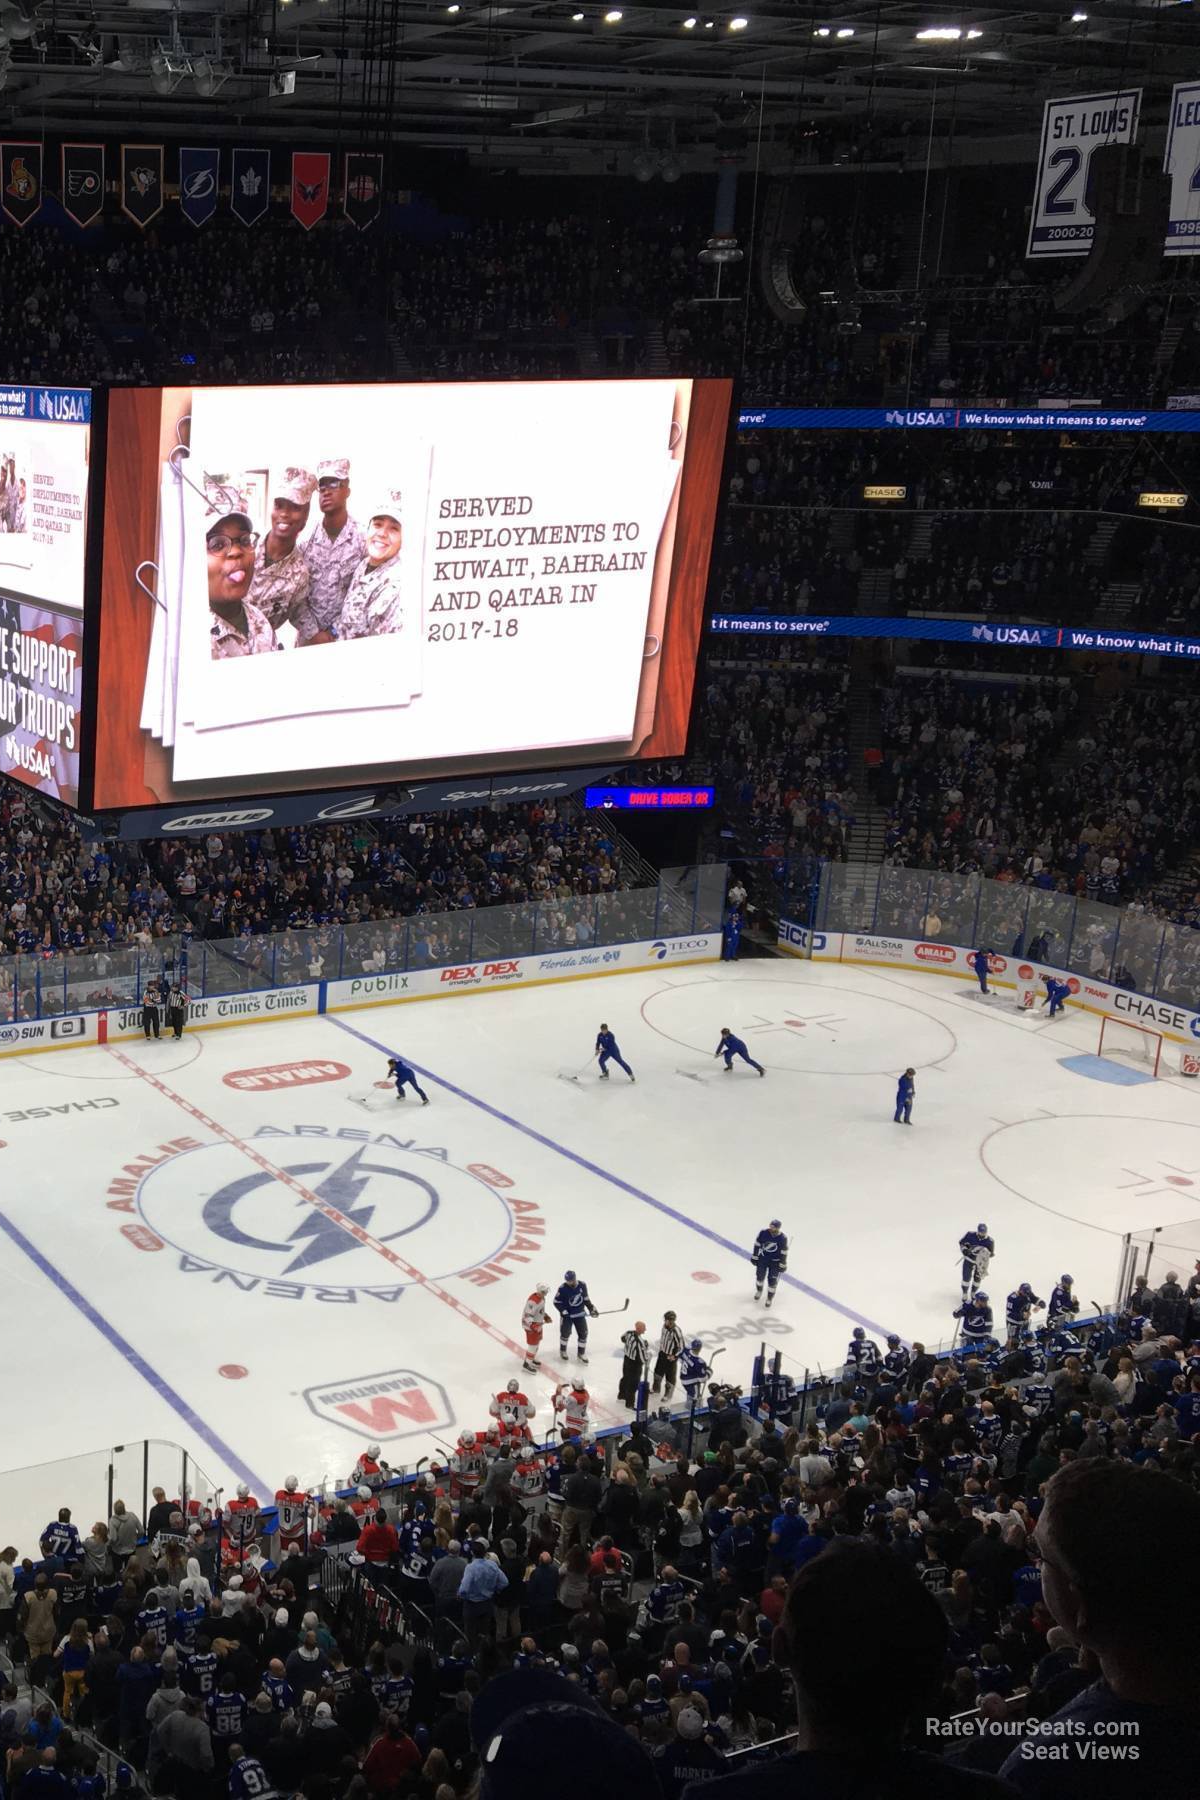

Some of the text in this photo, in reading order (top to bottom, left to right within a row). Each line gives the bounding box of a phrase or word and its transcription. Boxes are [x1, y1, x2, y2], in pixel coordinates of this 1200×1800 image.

[1052, 108, 1129, 139] ST. LOUIS
[965, 414, 982, 424] We
[984, 415, 1014, 424] know
[1016, 415, 1044, 425] what
[1046, 415, 1054, 425] it
[1057, 417, 1093, 425] means
[1096, 416, 1109, 425] to
[439, 496, 533, 519] SERVED
[1140, 495, 1176, 504] CHASE
[436, 522, 640, 550] DEPLOYMENTS TO
[433, 552, 647, 580] KUWAIT, BAHRAIN
[429, 584, 597, 612] AND QATAR IN
[428, 619, 519, 642] 2017-18
[719, 618, 728, 629] it
[731, 620, 772, 631] means
[774, 620, 787, 631] to
[1072, 633, 1093, 646] We
[1096, 634, 1135, 648] know
[1138, 636, 1171, 652] what
[1174, 638, 1184, 653] it
[11, 631, 77, 695] SUPPORT
[21, 686, 75, 750] TROOPS
[441, 782, 568, 802] Spectrum
[170, 812, 267, 828] AMALIE
[668, 939, 708, 951] TECO
[917, 947, 954, 958] AMALIE
[440, 966, 478, 981] DEX
[483, 960, 520, 977] DEX
[539, 956, 600, 970] Florida Blue
[1114, 993, 1187, 1030] CHASE
[21, 1026, 45, 1039] SUN
[3, 1097, 121, 1122] CHASE
[254, 1124, 449, 1162] ARENA
[106, 1136, 203, 1214] AMALIE
[459, 1198, 545, 1287] AMALIE
[180, 1255, 405, 1303] ARENA
[317, 1376, 418, 1405] MARATHON
[50, 1536, 72, 1554] 77
